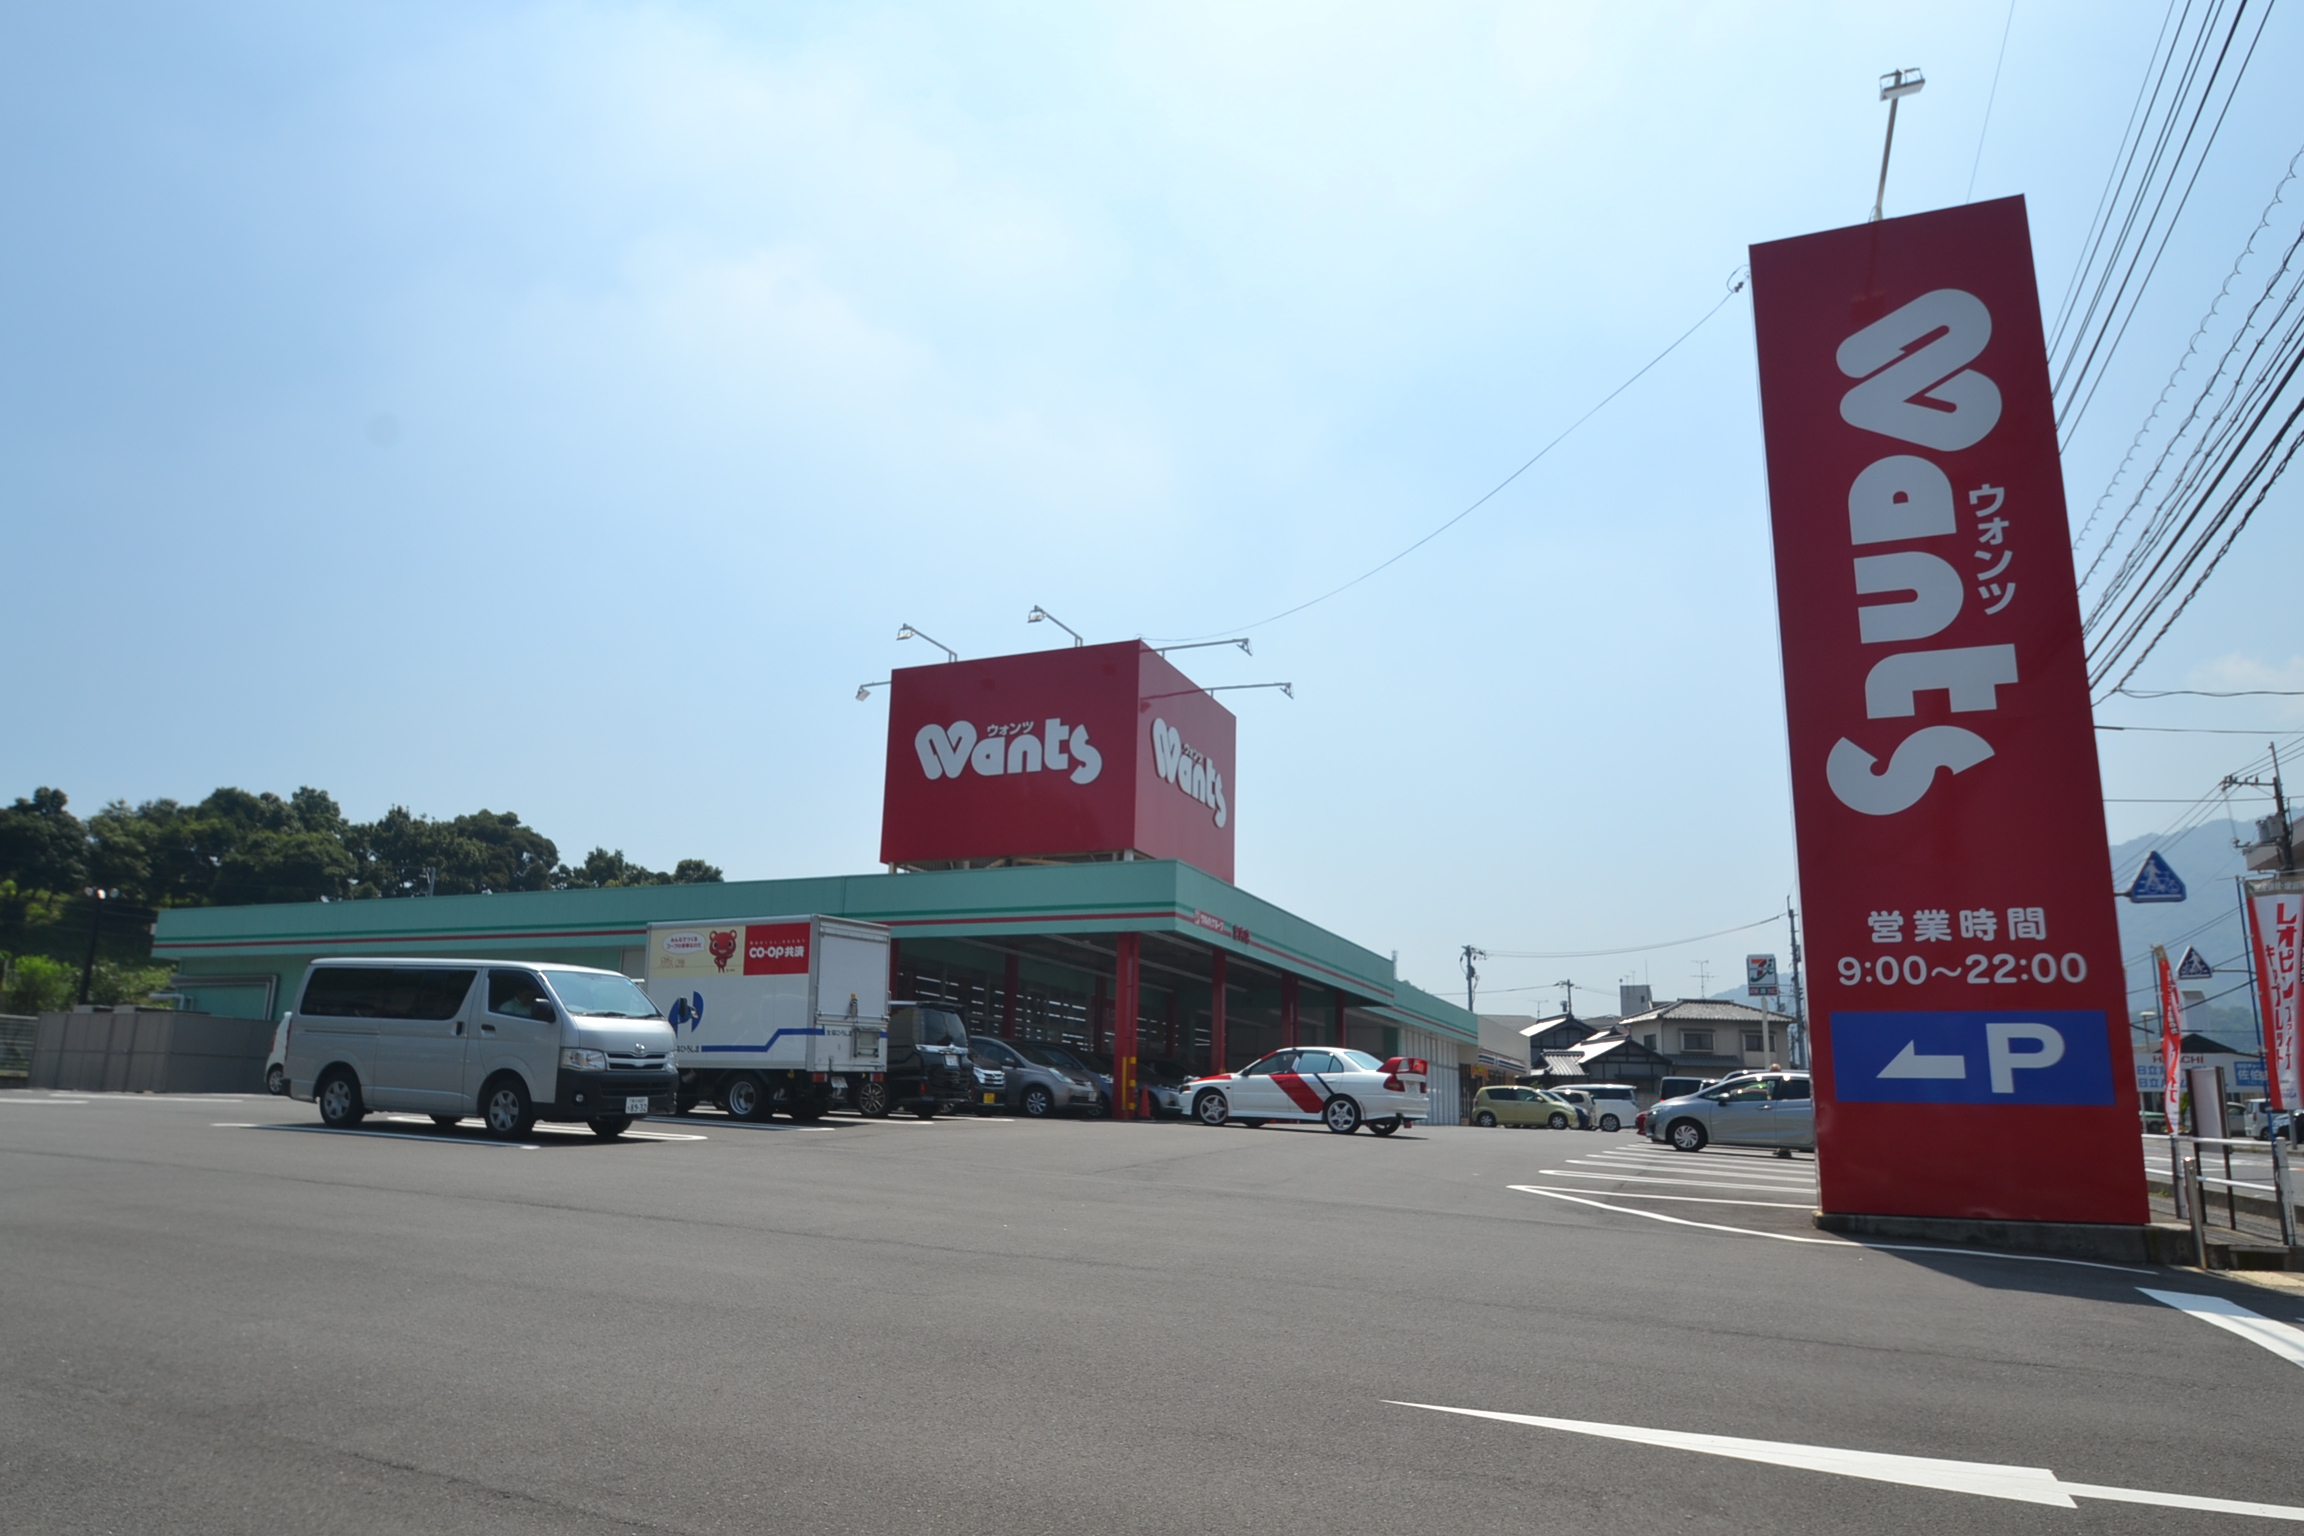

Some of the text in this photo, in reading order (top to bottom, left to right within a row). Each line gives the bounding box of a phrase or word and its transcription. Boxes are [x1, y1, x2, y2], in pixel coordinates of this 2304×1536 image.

[1826, 288, 2019, 816] Wants
[1969, 483, 2016, 615] ウォンツ
[914, 717, 1102, 785] Wants
[986, 720, 1034, 736] ウォンツ
[1152, 717, 1227, 828] Wants
[1867, 907, 2047, 943] 営業時間
[2277, 902, 2298, 1000] レオピン
[1837, 952, 2087, 986] 9:00～22:00
[1985, 1022, 2066, 1094] P
